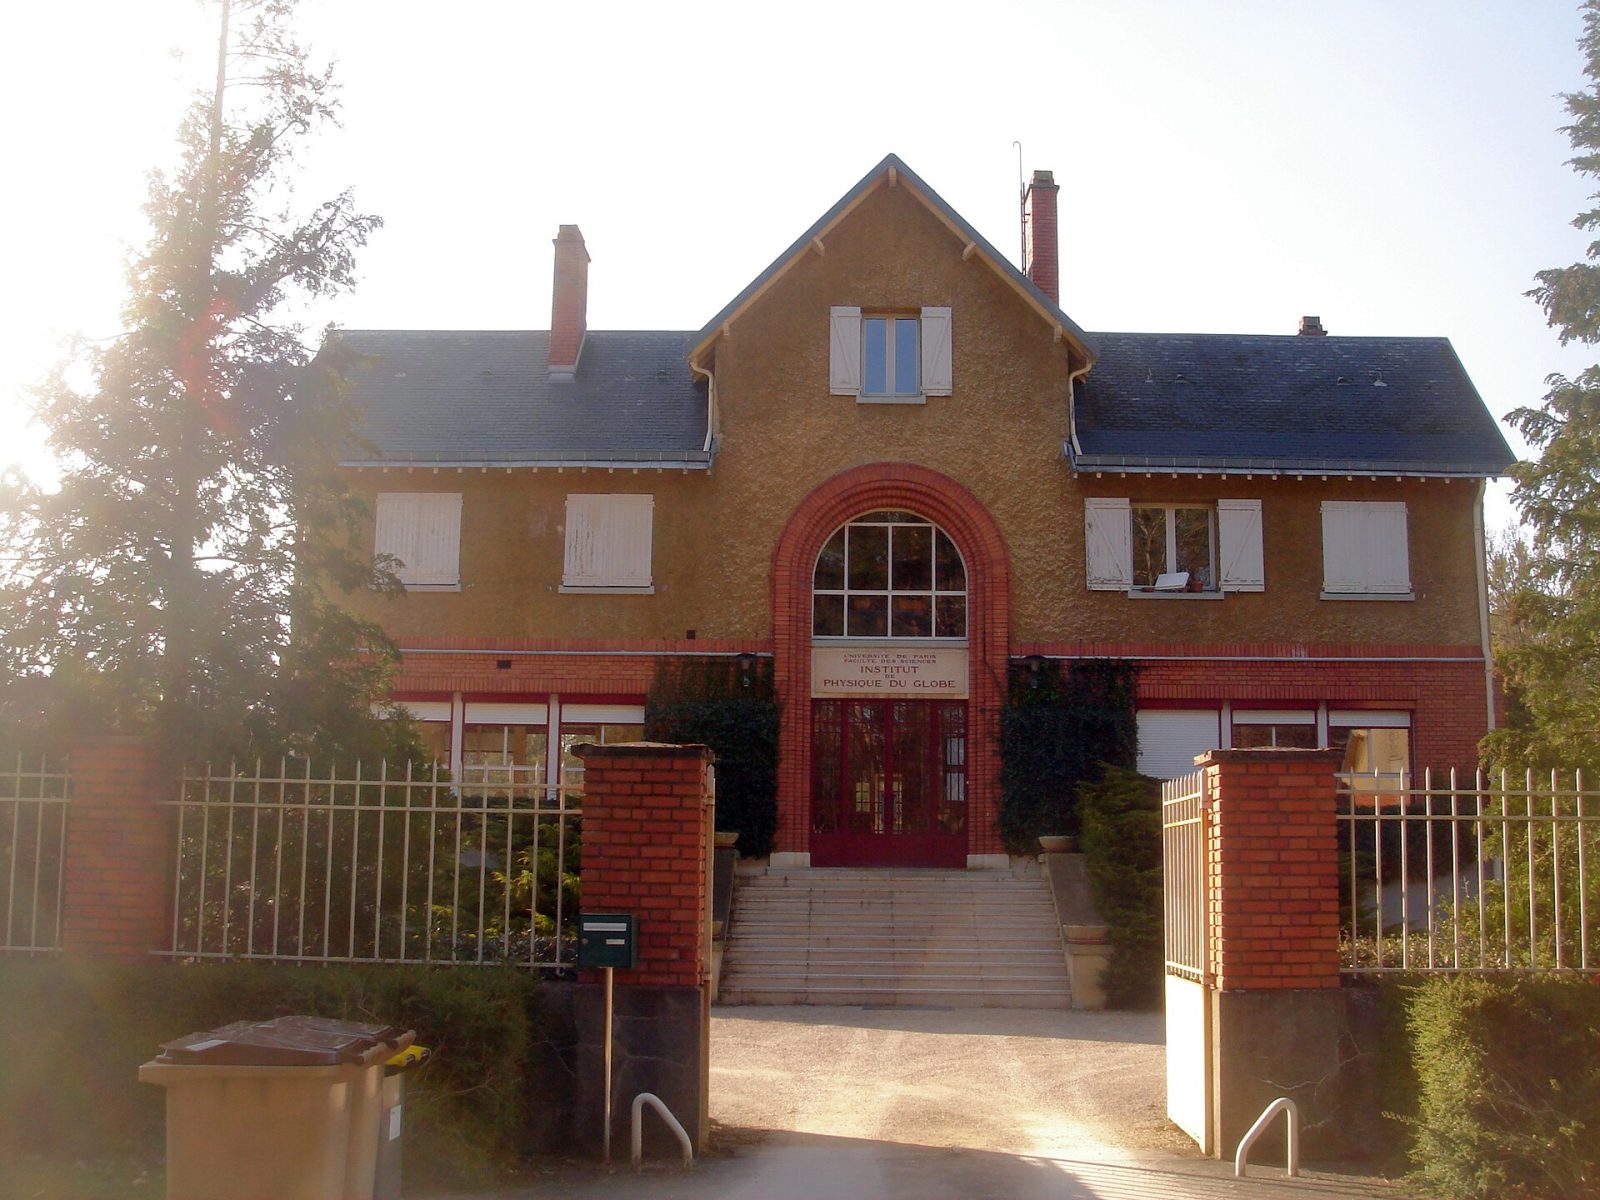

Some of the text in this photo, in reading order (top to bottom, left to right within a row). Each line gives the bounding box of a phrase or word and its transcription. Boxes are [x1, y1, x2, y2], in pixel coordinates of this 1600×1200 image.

[860, 666, 919, 674] INSTITUT
[823, 679, 956, 688] PHYSIQUE DU GLOBE
